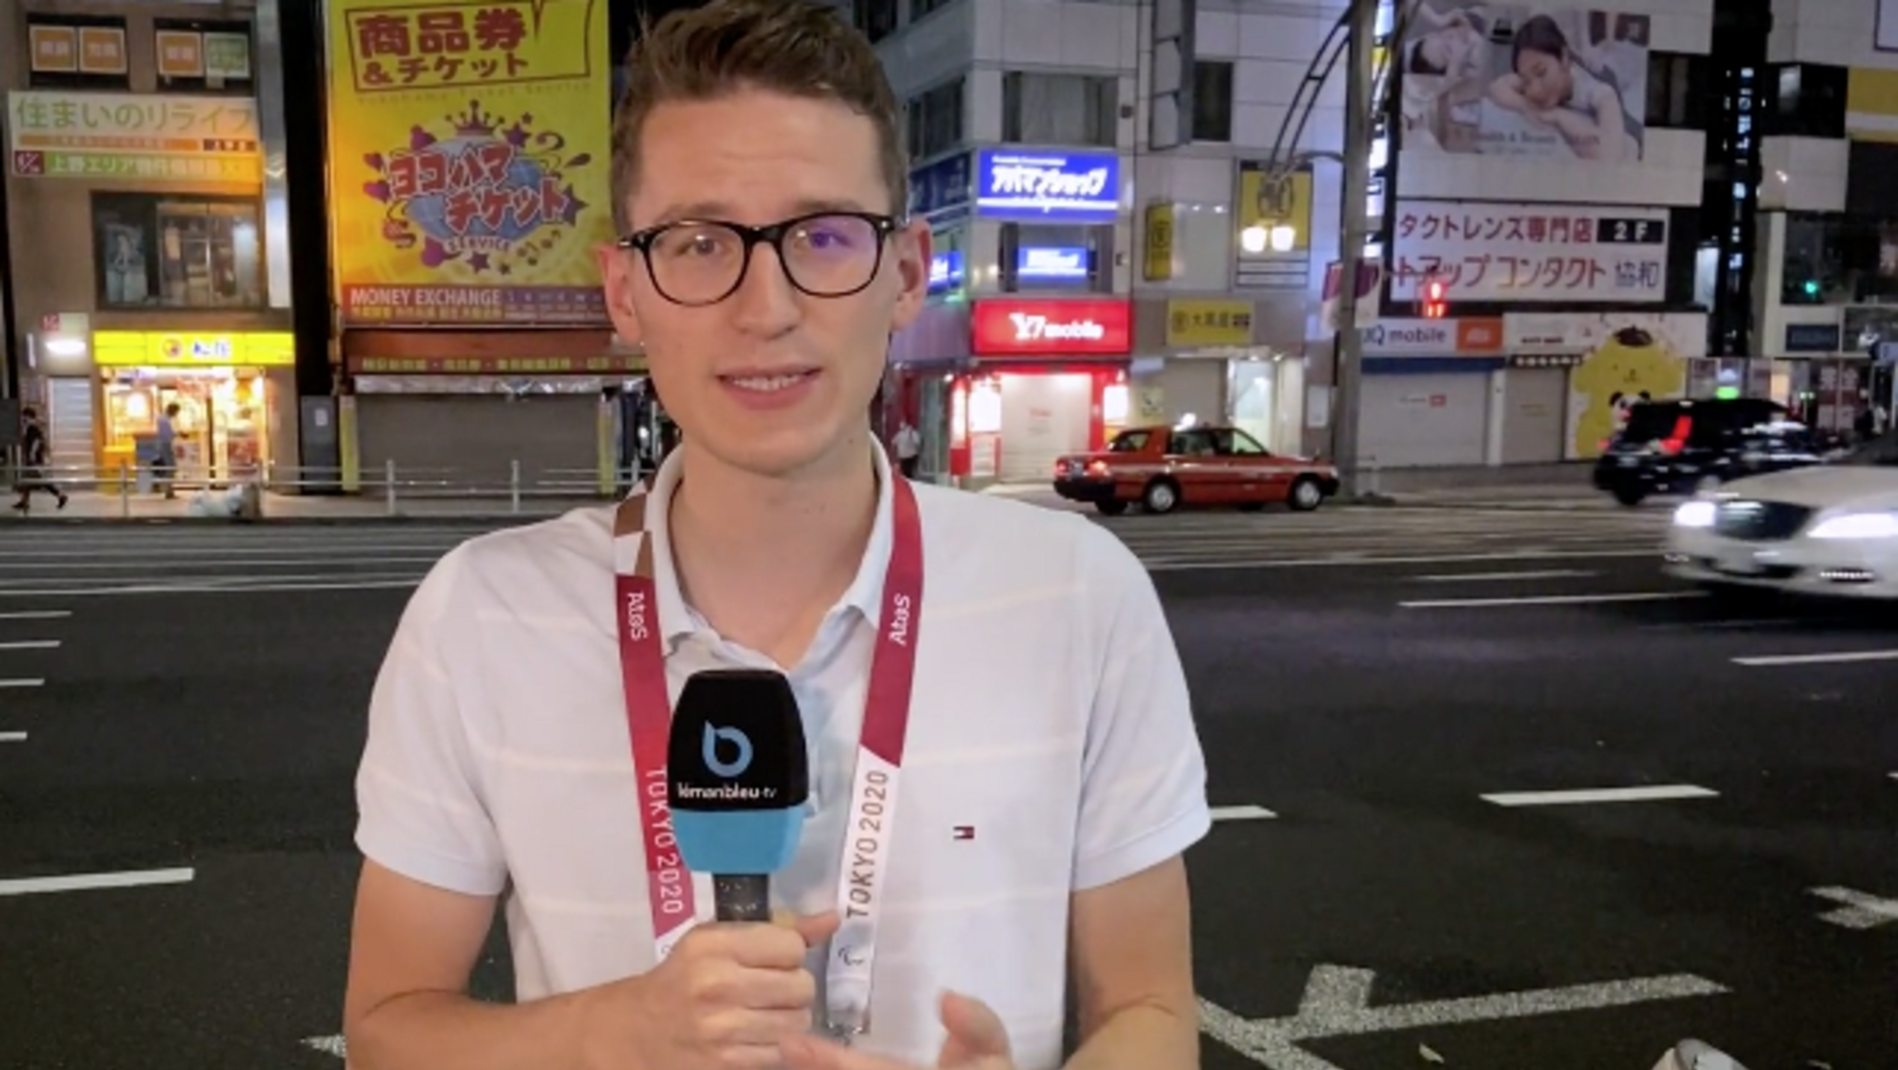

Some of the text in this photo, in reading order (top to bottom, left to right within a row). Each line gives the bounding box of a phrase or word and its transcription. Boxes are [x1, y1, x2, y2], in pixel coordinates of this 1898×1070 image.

[355, 8, 527, 58] 商品券
[362, 53, 529, 86] &チケット
[388, 144, 513, 199] ヨコハマ
[446, 177, 568, 234] チケット
[444, 235, 512, 254] SERVICE
[350, 288, 411, 306] MONEY
[414, 288, 500, 306] EXCHANGE
[1388, 327, 1447, 343] mobile
[626, 591, 648, 641] Atos
[888, 593, 911, 645] Atos
[646, 766, 684, 915] TOKYO 2020
[846, 770, 890, 919] TOKYO 2020
